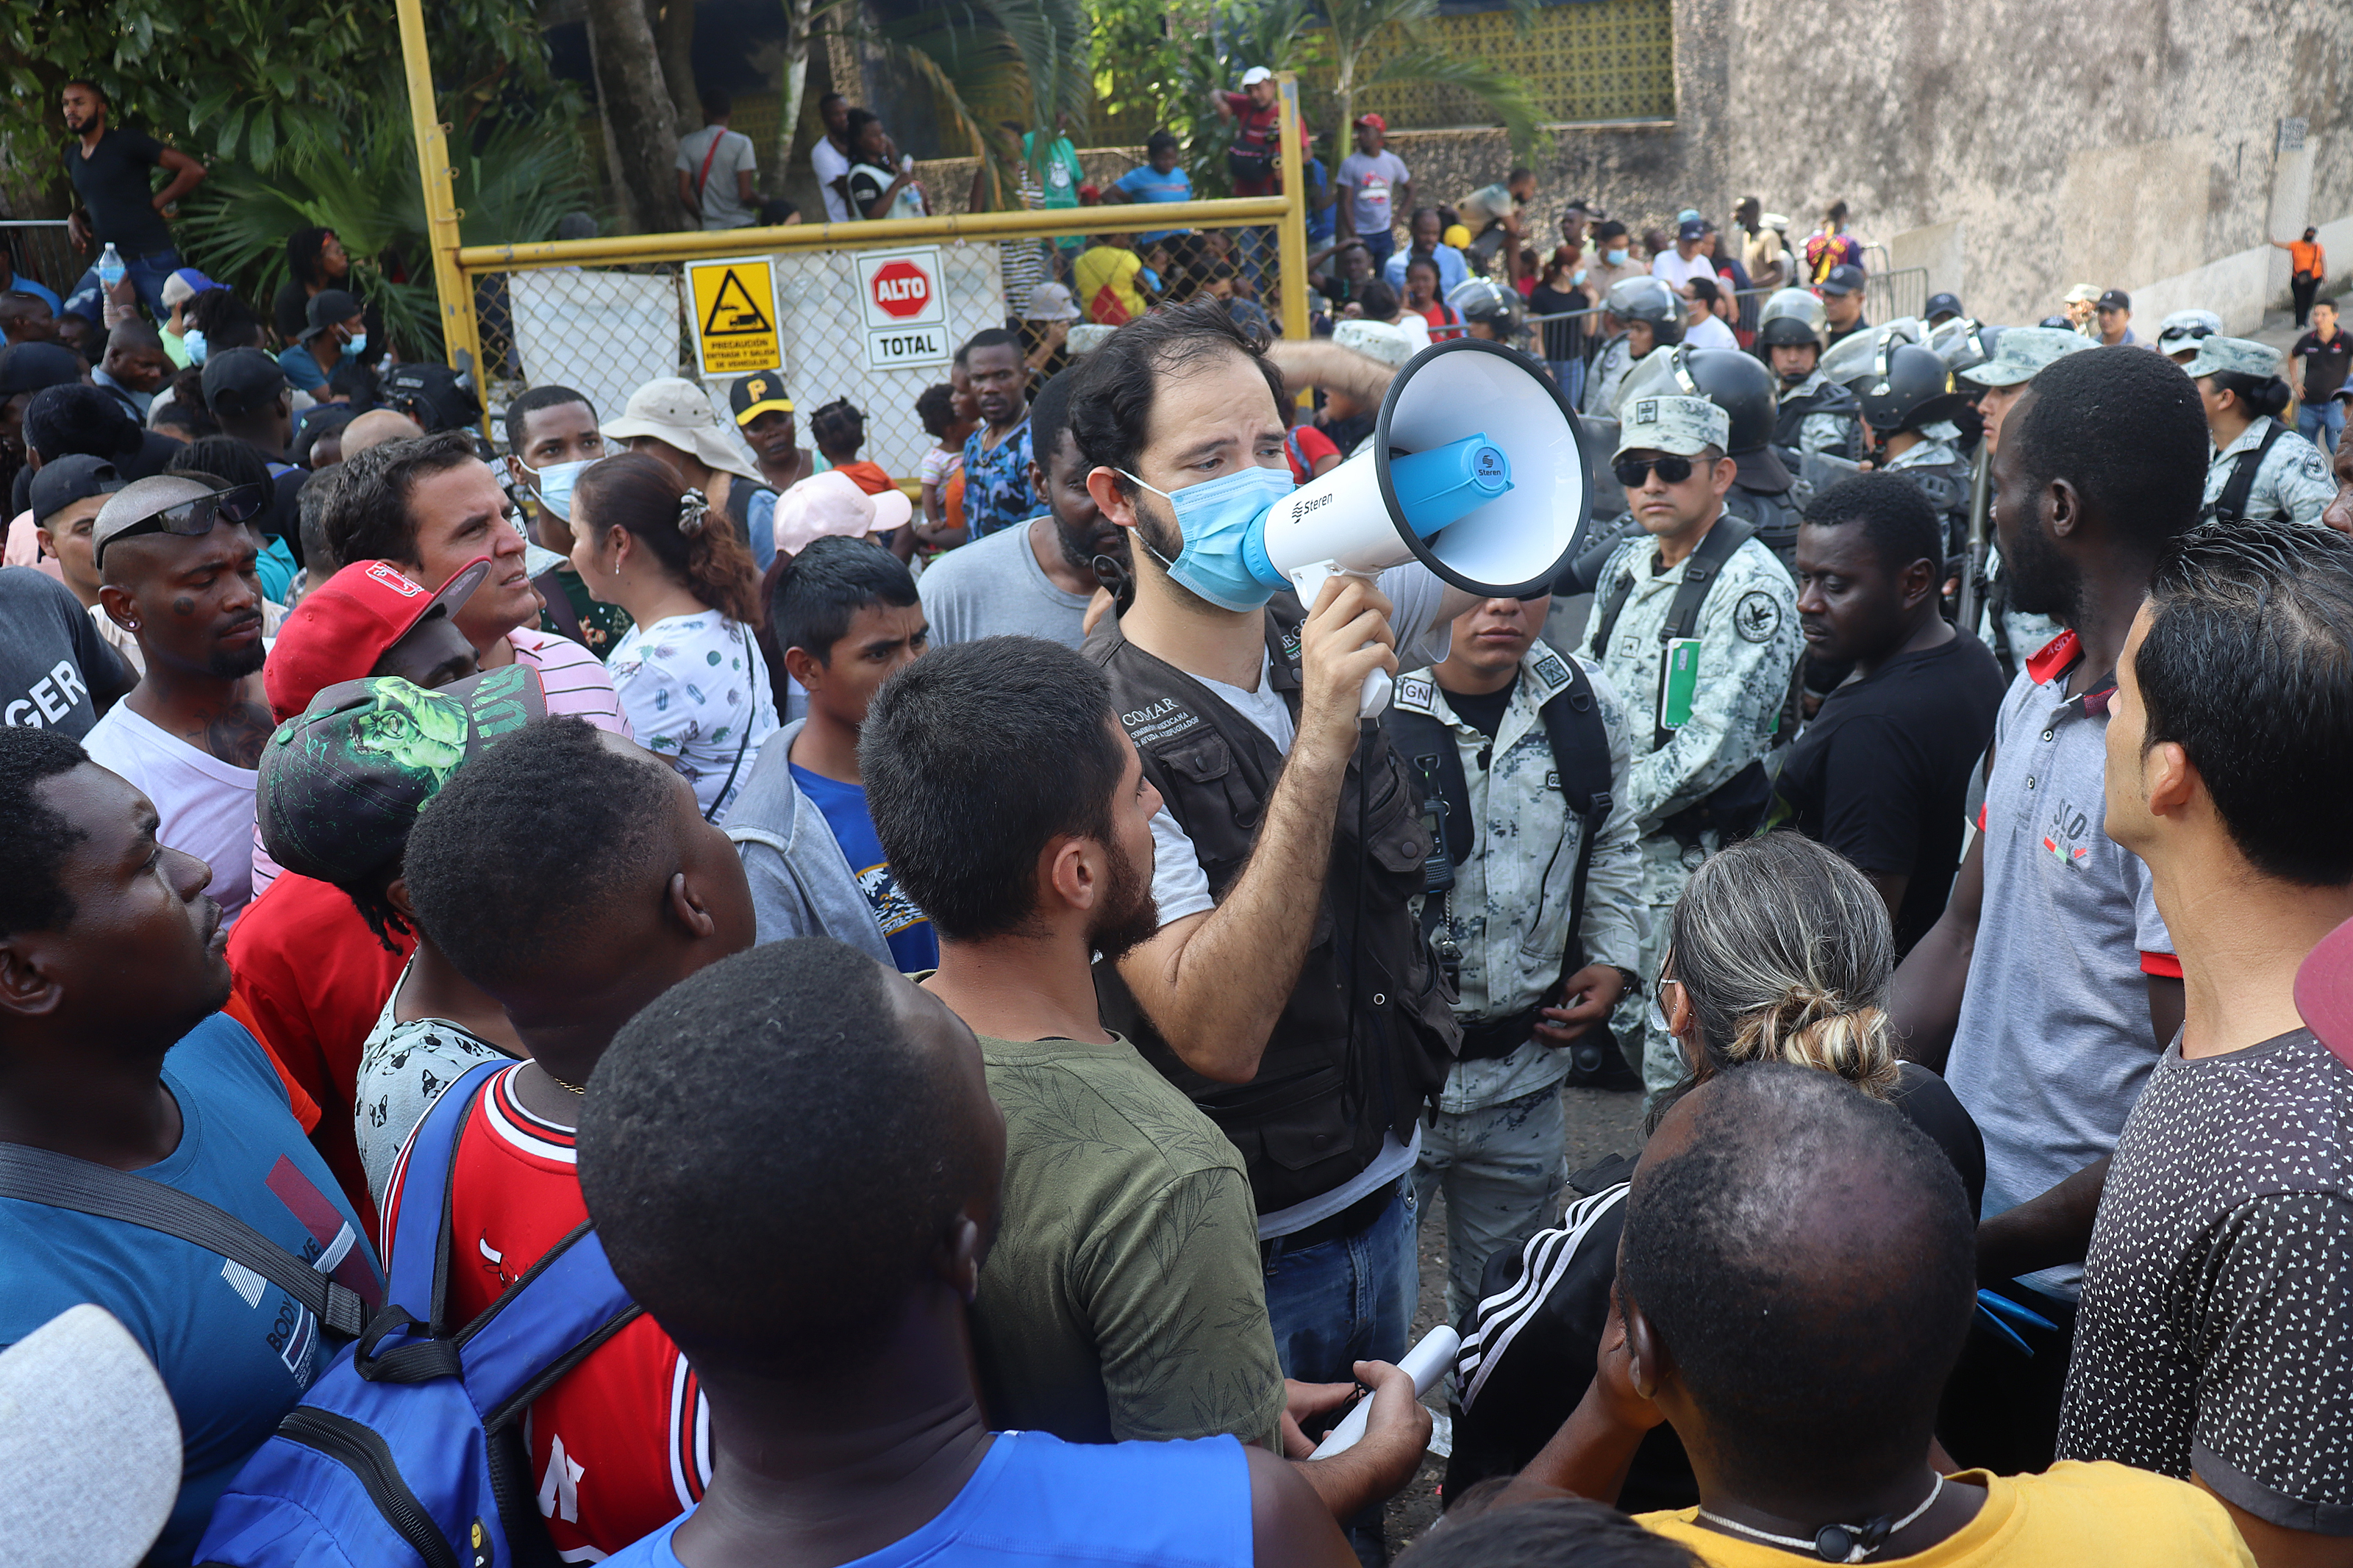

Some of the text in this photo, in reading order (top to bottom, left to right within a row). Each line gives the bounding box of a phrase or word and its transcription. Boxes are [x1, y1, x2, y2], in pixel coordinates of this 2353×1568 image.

[877, 276, 926, 302] ALTO
[879, 334, 938, 357] TOTAL
[747, 378, 768, 404] P
[1304, 493, 1333, 515] Steren
[4, 659, 87, 730] GER
[1405, 684, 1429, 702] GN
[471, 663, 528, 751] ULK
[1122, 698, 1179, 726] COMAR
[1140, 732, 1160, 745] AYUDA
[265, 1294, 297, 1353] BODY
